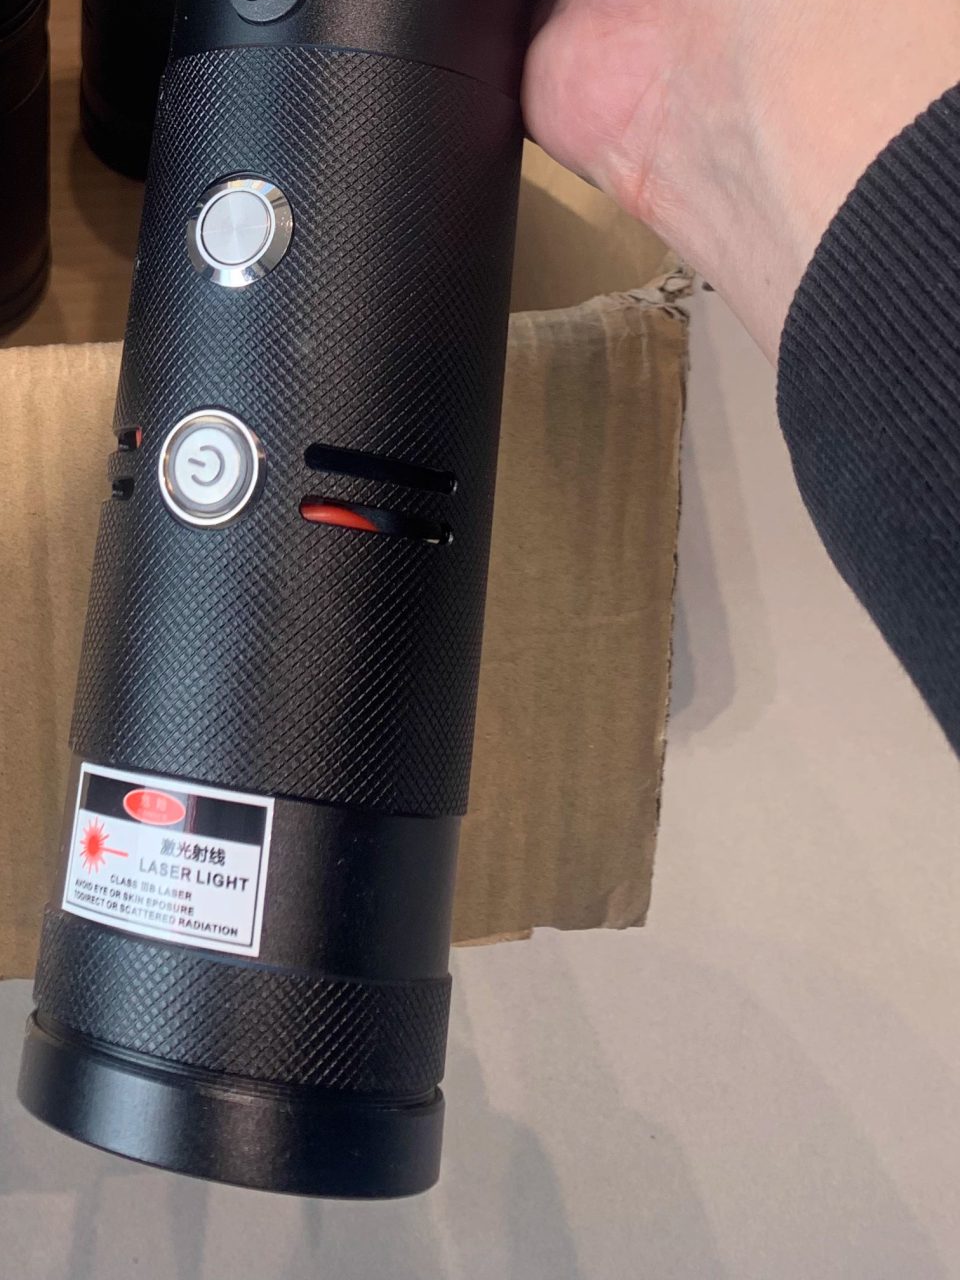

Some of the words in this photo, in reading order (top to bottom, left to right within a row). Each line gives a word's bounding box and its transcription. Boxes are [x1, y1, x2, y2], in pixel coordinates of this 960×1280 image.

[160, 838, 226, 866] 激光射线
[110, 874, 137, 889] CLASS
[158, 884, 192, 901] LASER
[139, 858, 191, 882] LASER
[196, 870, 249, 892] LIGHT
[94, 884, 107, 896] EYE
[109, 888, 121, 900] OR
[123, 891, 143, 905] SKIN
[146, 895, 195, 916] EPOSURE
[107, 900, 118, 911] OR
[119, 904, 177, 925] SCATTERED
[178, 917, 239, 937] RADIATION
